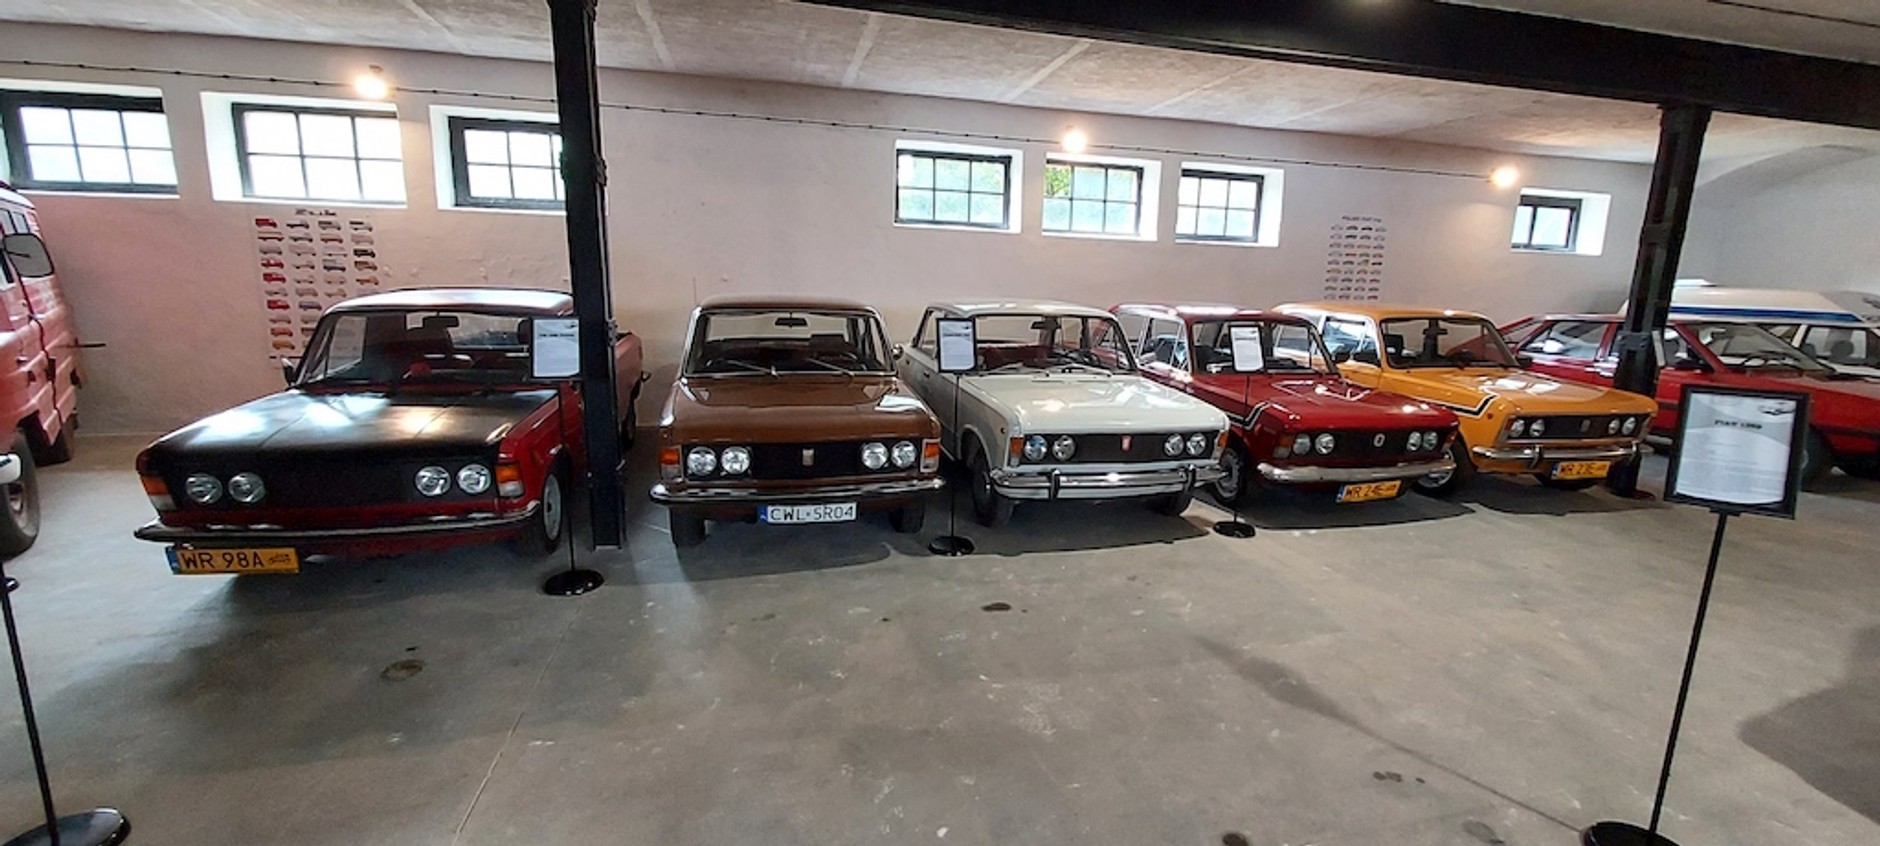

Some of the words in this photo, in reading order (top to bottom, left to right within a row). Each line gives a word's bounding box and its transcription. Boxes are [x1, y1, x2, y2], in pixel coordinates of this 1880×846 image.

[1344, 486, 1362, 499] WR
[770, 508, 806, 521] CWL
[181, 552, 215, 569] WR
[221, 551, 264, 568] 98A
